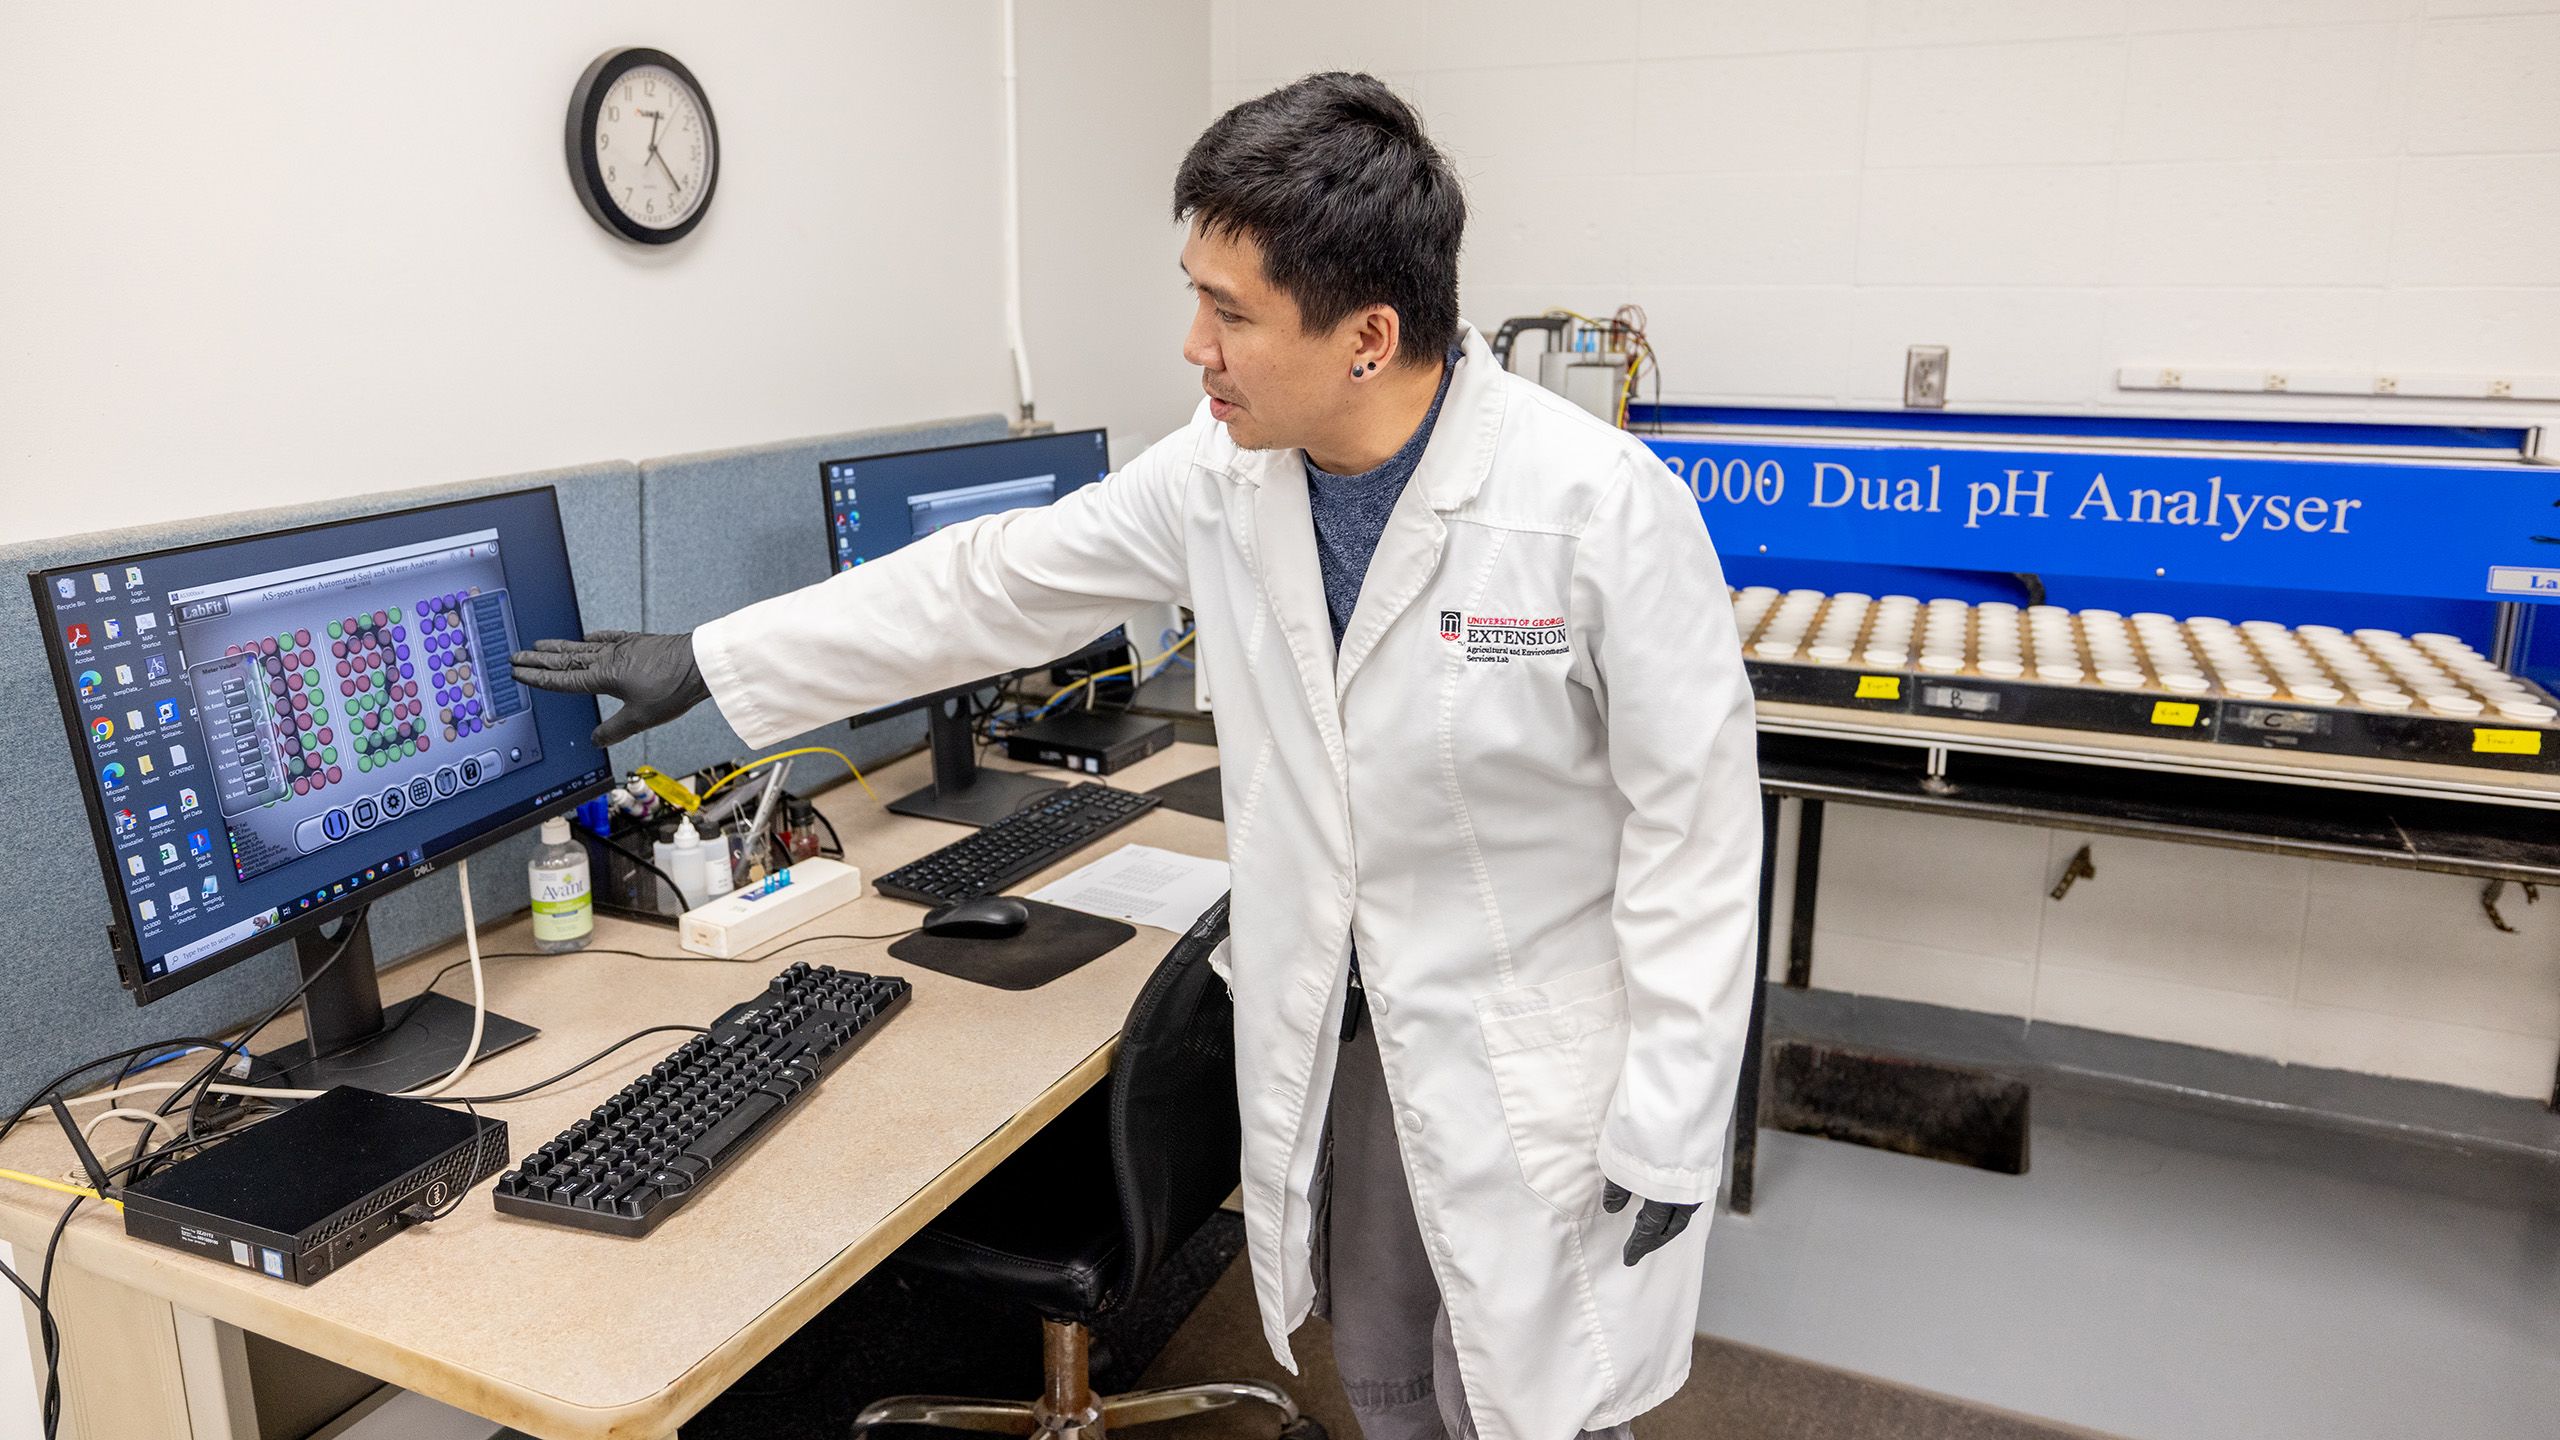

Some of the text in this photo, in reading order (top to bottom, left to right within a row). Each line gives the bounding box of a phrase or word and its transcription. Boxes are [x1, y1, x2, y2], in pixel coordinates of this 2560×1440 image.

[624, 86, 633, 101] 11
[644, 80, 656, 97] 12
[668, 93, 673, 108] 1
[608, 106, 620, 122] 10
[682, 116, 691, 131] 2
[601, 134, 609, 150] 9
[690, 146, 696, 161] 3
[609, 166, 616, 182] 8
[682, 175, 689, 186] 4
[625, 188, 633, 202] 7
[667, 193, 675, 209] 5
[646, 198, 654, 214] 6
[1809, 461, 1943, 513] Dual
[1963, 469, 2054, 528] pH
[2070, 472, 2363, 542] Analyser
[295, 585, 316, 594] series
[317, 573, 357, 590] Automated
[358, 570, 373, 580] Soil
[374, 567, 386, 577] and
[387, 564, 408, 575] Water
[410, 559, 438, 570] Analyser
[105, 595, 117, 603] map
[130, 596, 151, 605] Shortcut
[57, 602, 76, 611] Recycle
[182, 601, 223, 620] LabFit
[1467, 617, 1517, 625] UNIVERSITY
[1519, 618, 1530, 626] OF
[1467, 628, 1566, 645] EXTENSION
[103, 640, 132, 650] screenshots
[141, 641, 162, 650] Shortcut
[1467, 645, 1508, 655] Agricultural
[1510, 648, 1520, 656] and
[75, 648, 92, 657] Adobe
[1467, 654, 1496, 663] Services
[75, 656, 95, 665] Acrobat
[83, 694, 107, 704] Microsoft
[1951, 689, 1964, 709] B
[90, 702, 103, 711] Edge
[254, 708, 266, 726] 2
[2264, 712, 2284, 728] C
[160, 721, 183, 731] Microsoft
[123, 732, 145, 743] Updates
[135, 739, 148, 747] Chris
[97, 741, 116, 750] Google
[237, 741, 249, 750] NaN
[260, 738, 272, 756] 3
[98, 748, 118, 757] Chrome
[141, 776, 160, 785] Volume
[244, 770, 256, 779] NaN
[269, 766, 280, 783] 4
[106, 785, 130, 796] Microsoft
[113, 794, 126, 803] Edge
[192, 809, 203, 817] Data
[149, 819, 175, 832] Annotation
[118, 837, 144, 850] Uninstaller
[197, 860, 213, 869] Sketch
[414, 862, 435, 878] DELL
[131, 875, 151, 887] AS3000
[130, 881, 156, 895] install files
[542, 880, 584, 900] Avant
[206, 902, 225, 914] Shortcut
[177, 913, 197, 925] Shortcut
[142, 920, 162, 931] AS3000
[182, 931, 236, 960] Type here to search
[734, 1009, 759, 1025] DELL
